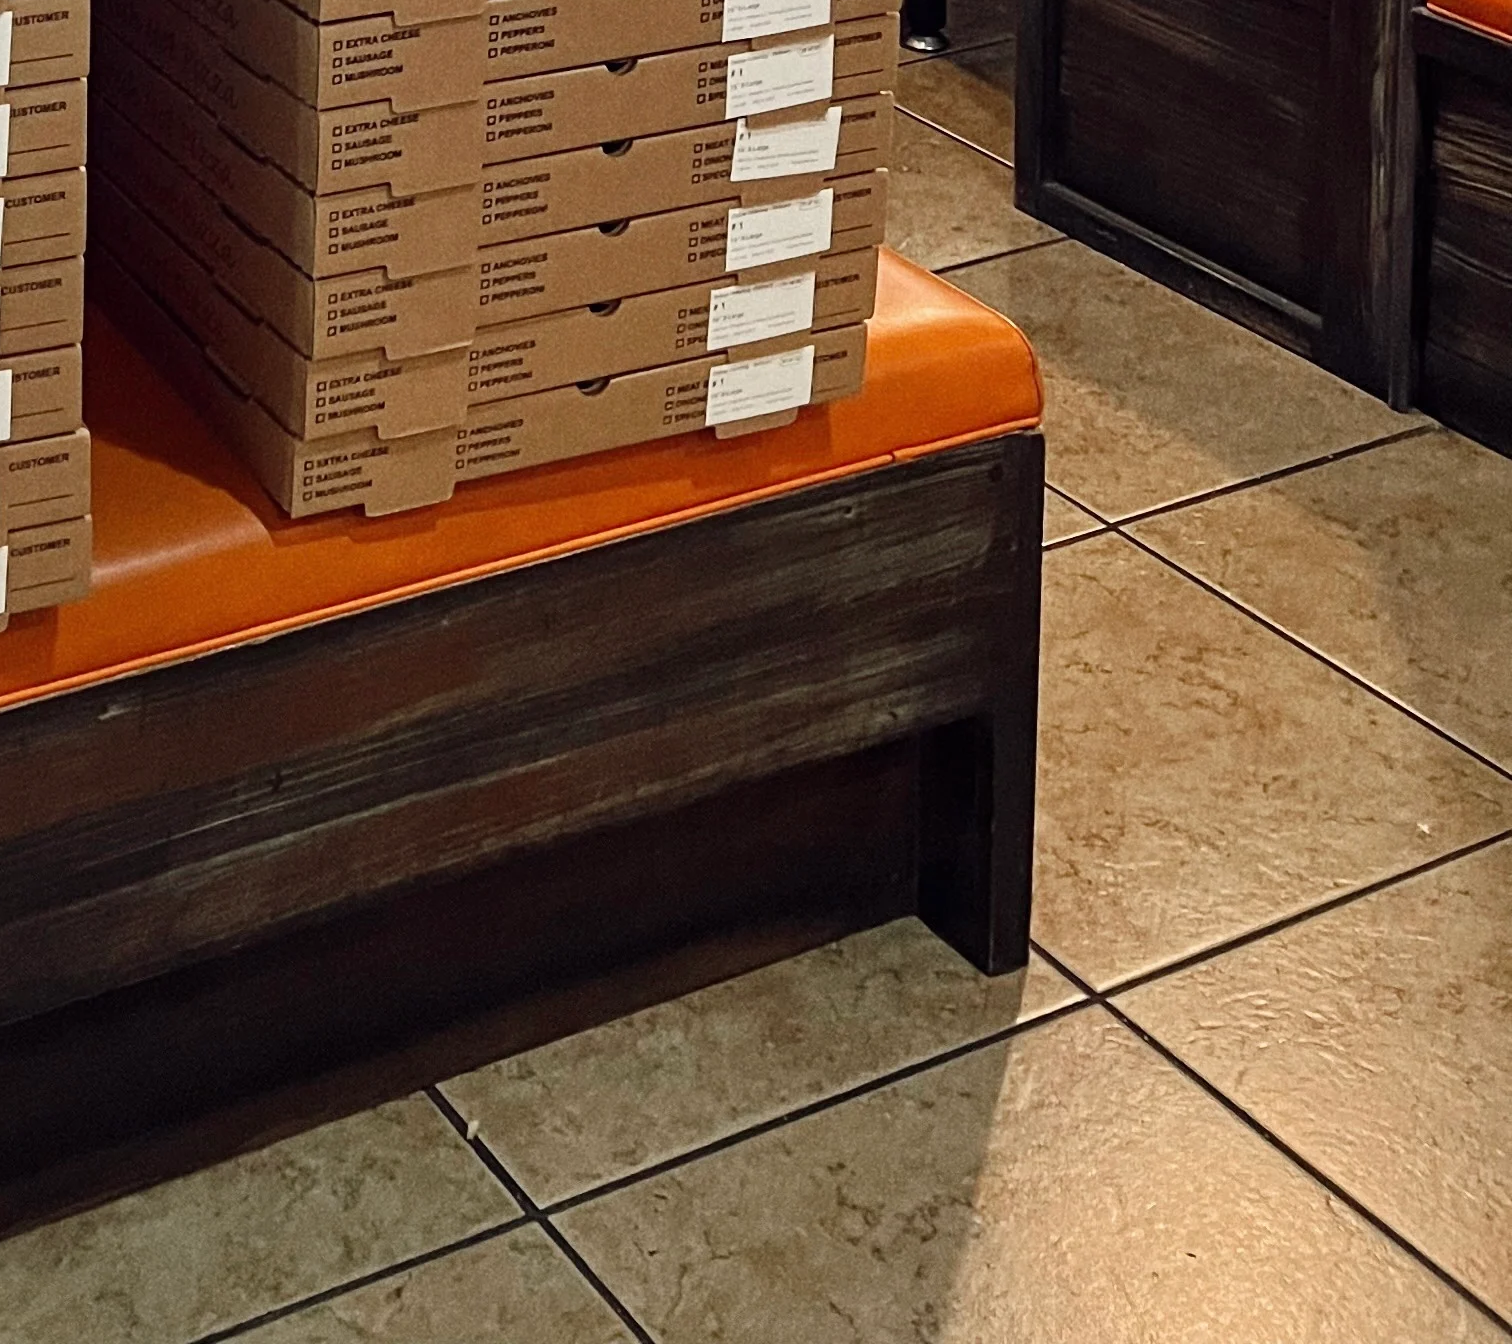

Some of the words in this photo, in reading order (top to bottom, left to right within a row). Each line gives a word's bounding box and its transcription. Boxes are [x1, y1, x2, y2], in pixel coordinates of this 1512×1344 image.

[4, 191, 67, 209] CUSTOMER
[8, 453, 70, 472] CUSTOMER
[10, 538, 71, 557] CUSTOMER
